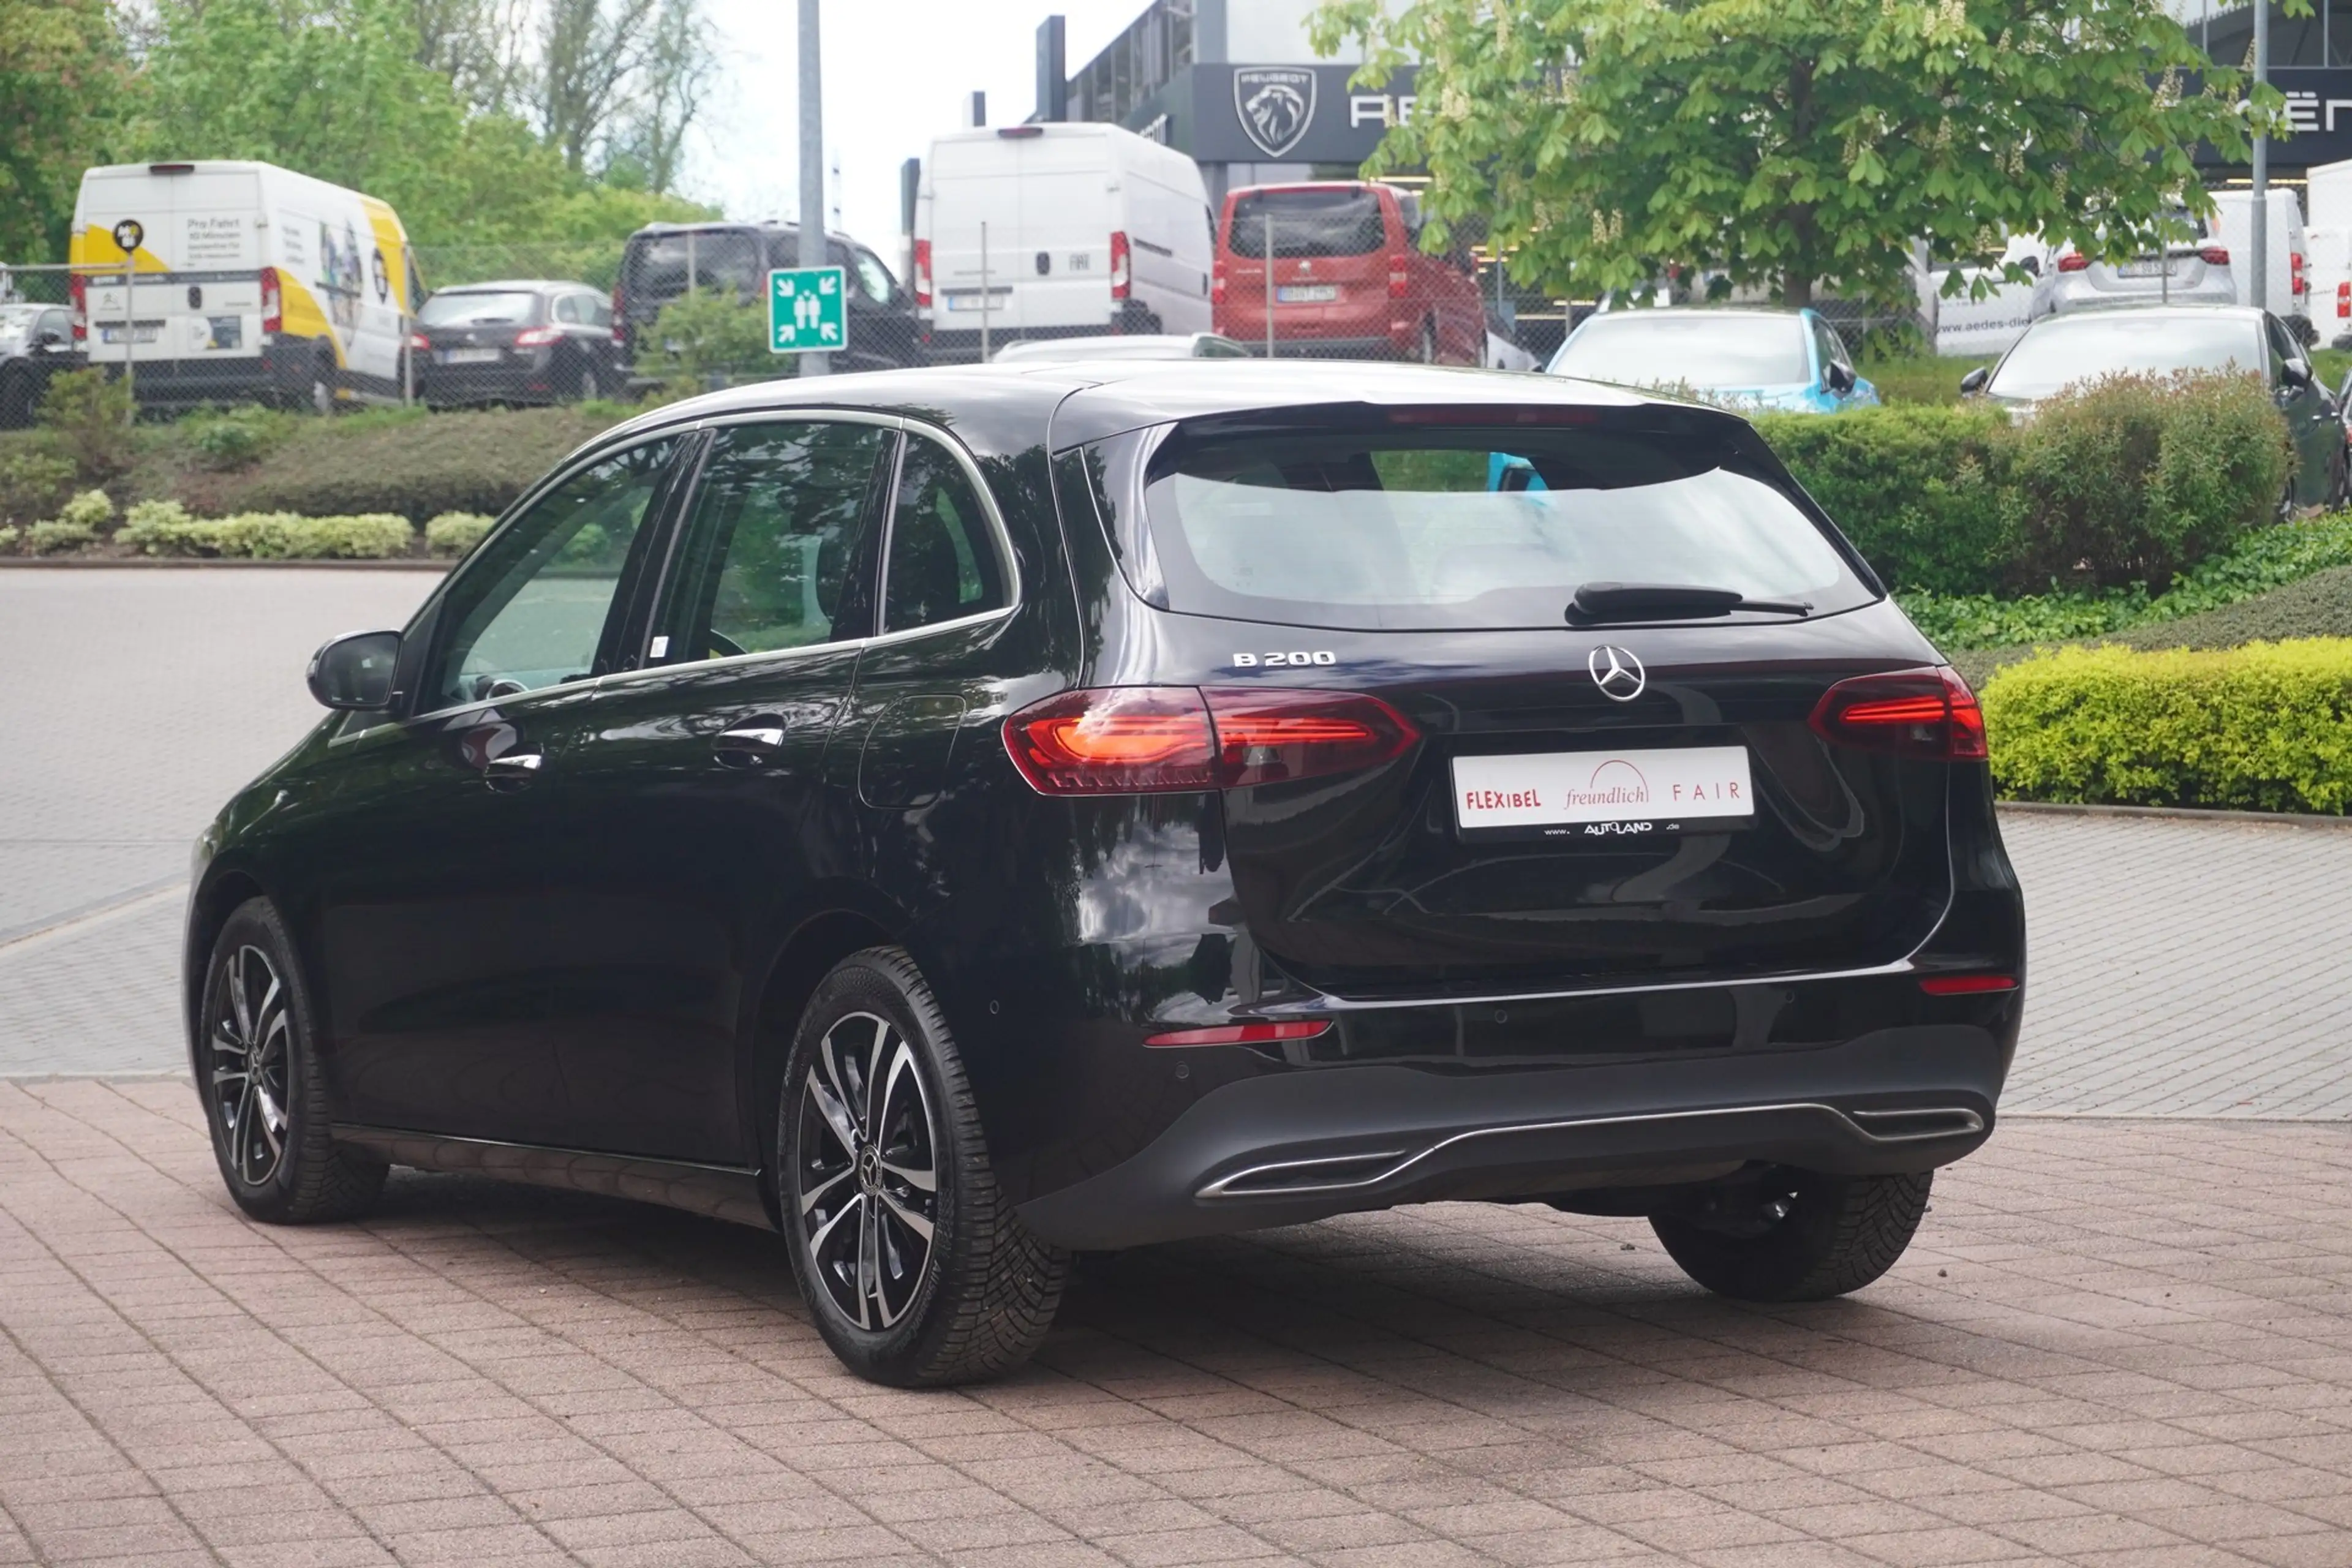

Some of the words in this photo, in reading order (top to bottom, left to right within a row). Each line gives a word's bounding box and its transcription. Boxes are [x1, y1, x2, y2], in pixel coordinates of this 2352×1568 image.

[1240, 72, 1310, 85] PEUGEOT
[1233, 653, 1257, 667] B
[1264, 651, 1336, 666] 200
[1466, 789, 1541, 810] FLEXIBEL
[1564, 786, 1644, 810] freundlich
[1673, 782, 1740, 801] FAIR
[1584, 822, 1653, 835] AUTOLAND
